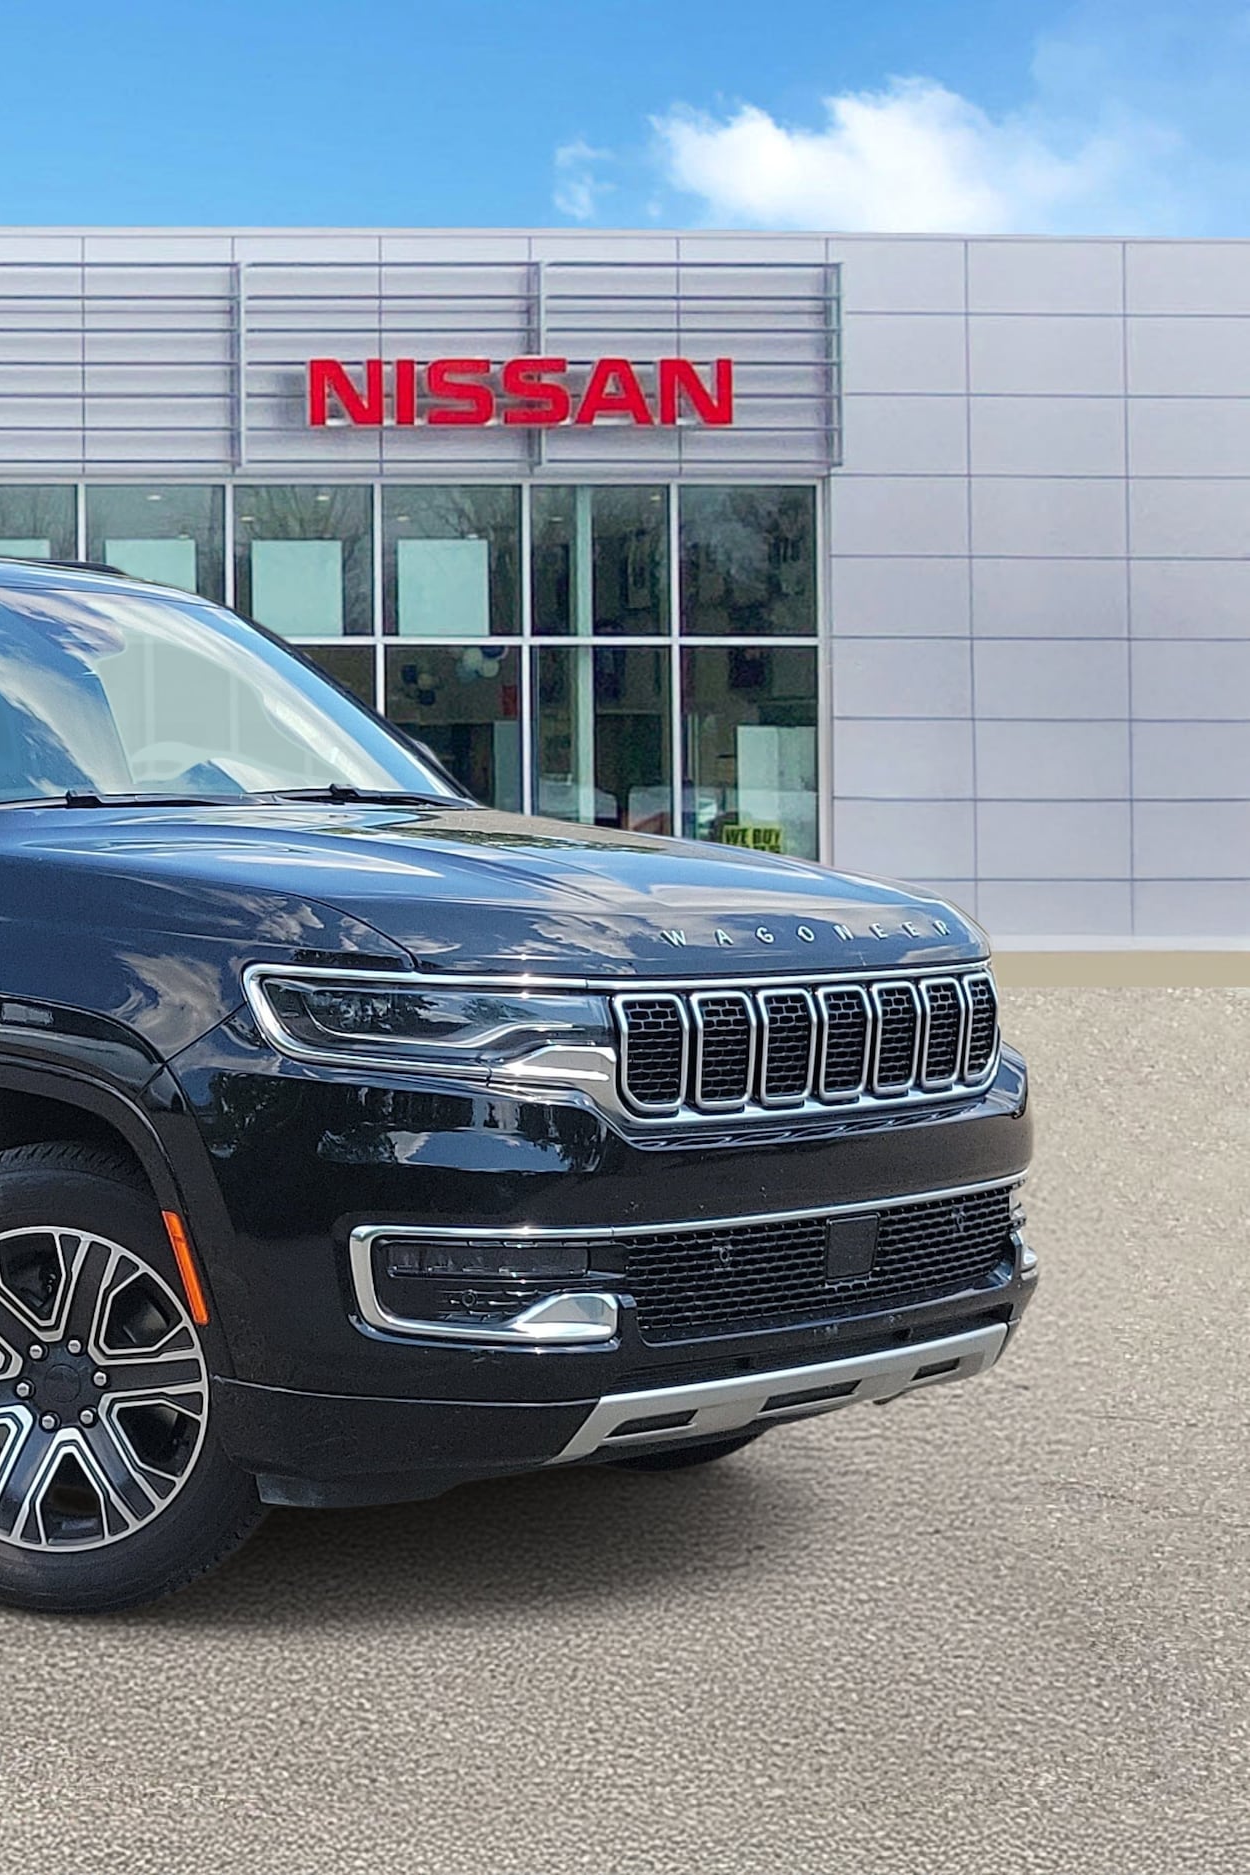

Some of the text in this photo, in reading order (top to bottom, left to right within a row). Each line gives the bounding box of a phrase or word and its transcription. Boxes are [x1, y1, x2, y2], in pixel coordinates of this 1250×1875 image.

[308, 357, 733, 427] NISSAN
[725, 828, 781, 844] WE BUY
[660, 920, 950, 948] WAGONEER
